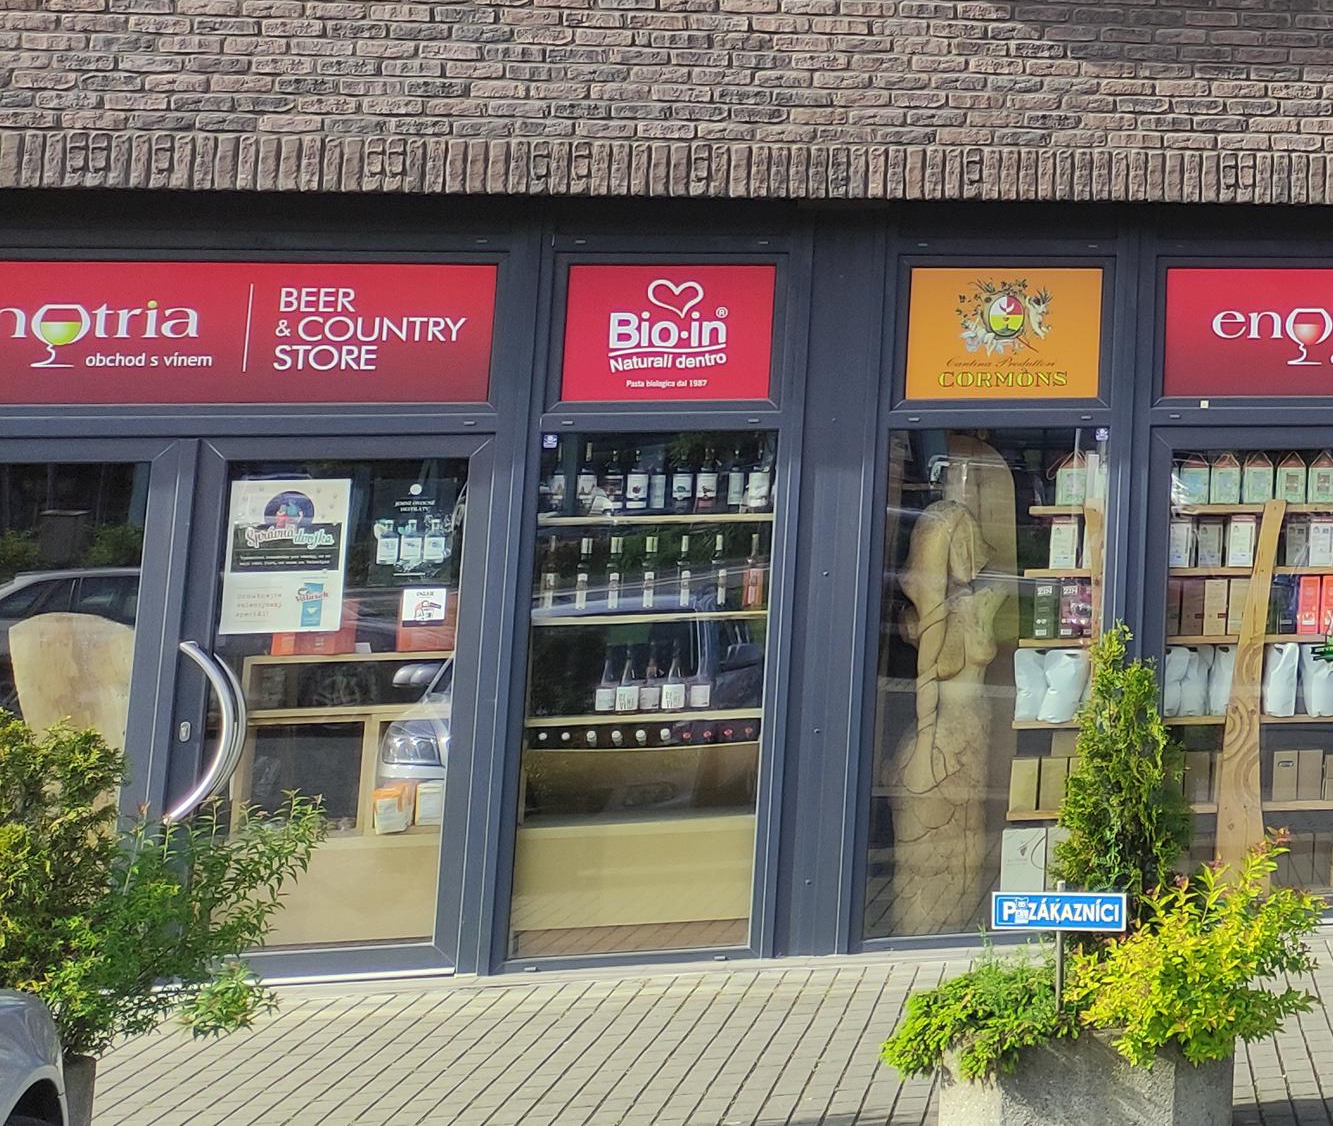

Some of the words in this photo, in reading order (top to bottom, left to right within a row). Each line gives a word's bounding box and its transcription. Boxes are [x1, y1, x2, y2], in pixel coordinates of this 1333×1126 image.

[279, 287, 356, 313] BEER
[0, 300, 200, 367] notria
[275, 319, 291, 337] &
[297, 315, 468, 342] COUNTRY
[85, 352, 146, 368] obchod
[150, 355, 159, 367] s
[164, 351, 213, 368] vínem
[273, 344, 378, 371] STORE
[676, 353, 727, 369] dentro
[646, 379, 676, 389] biologica
[1028, 898, 1119, 923] ZÁKAZNÍCI
